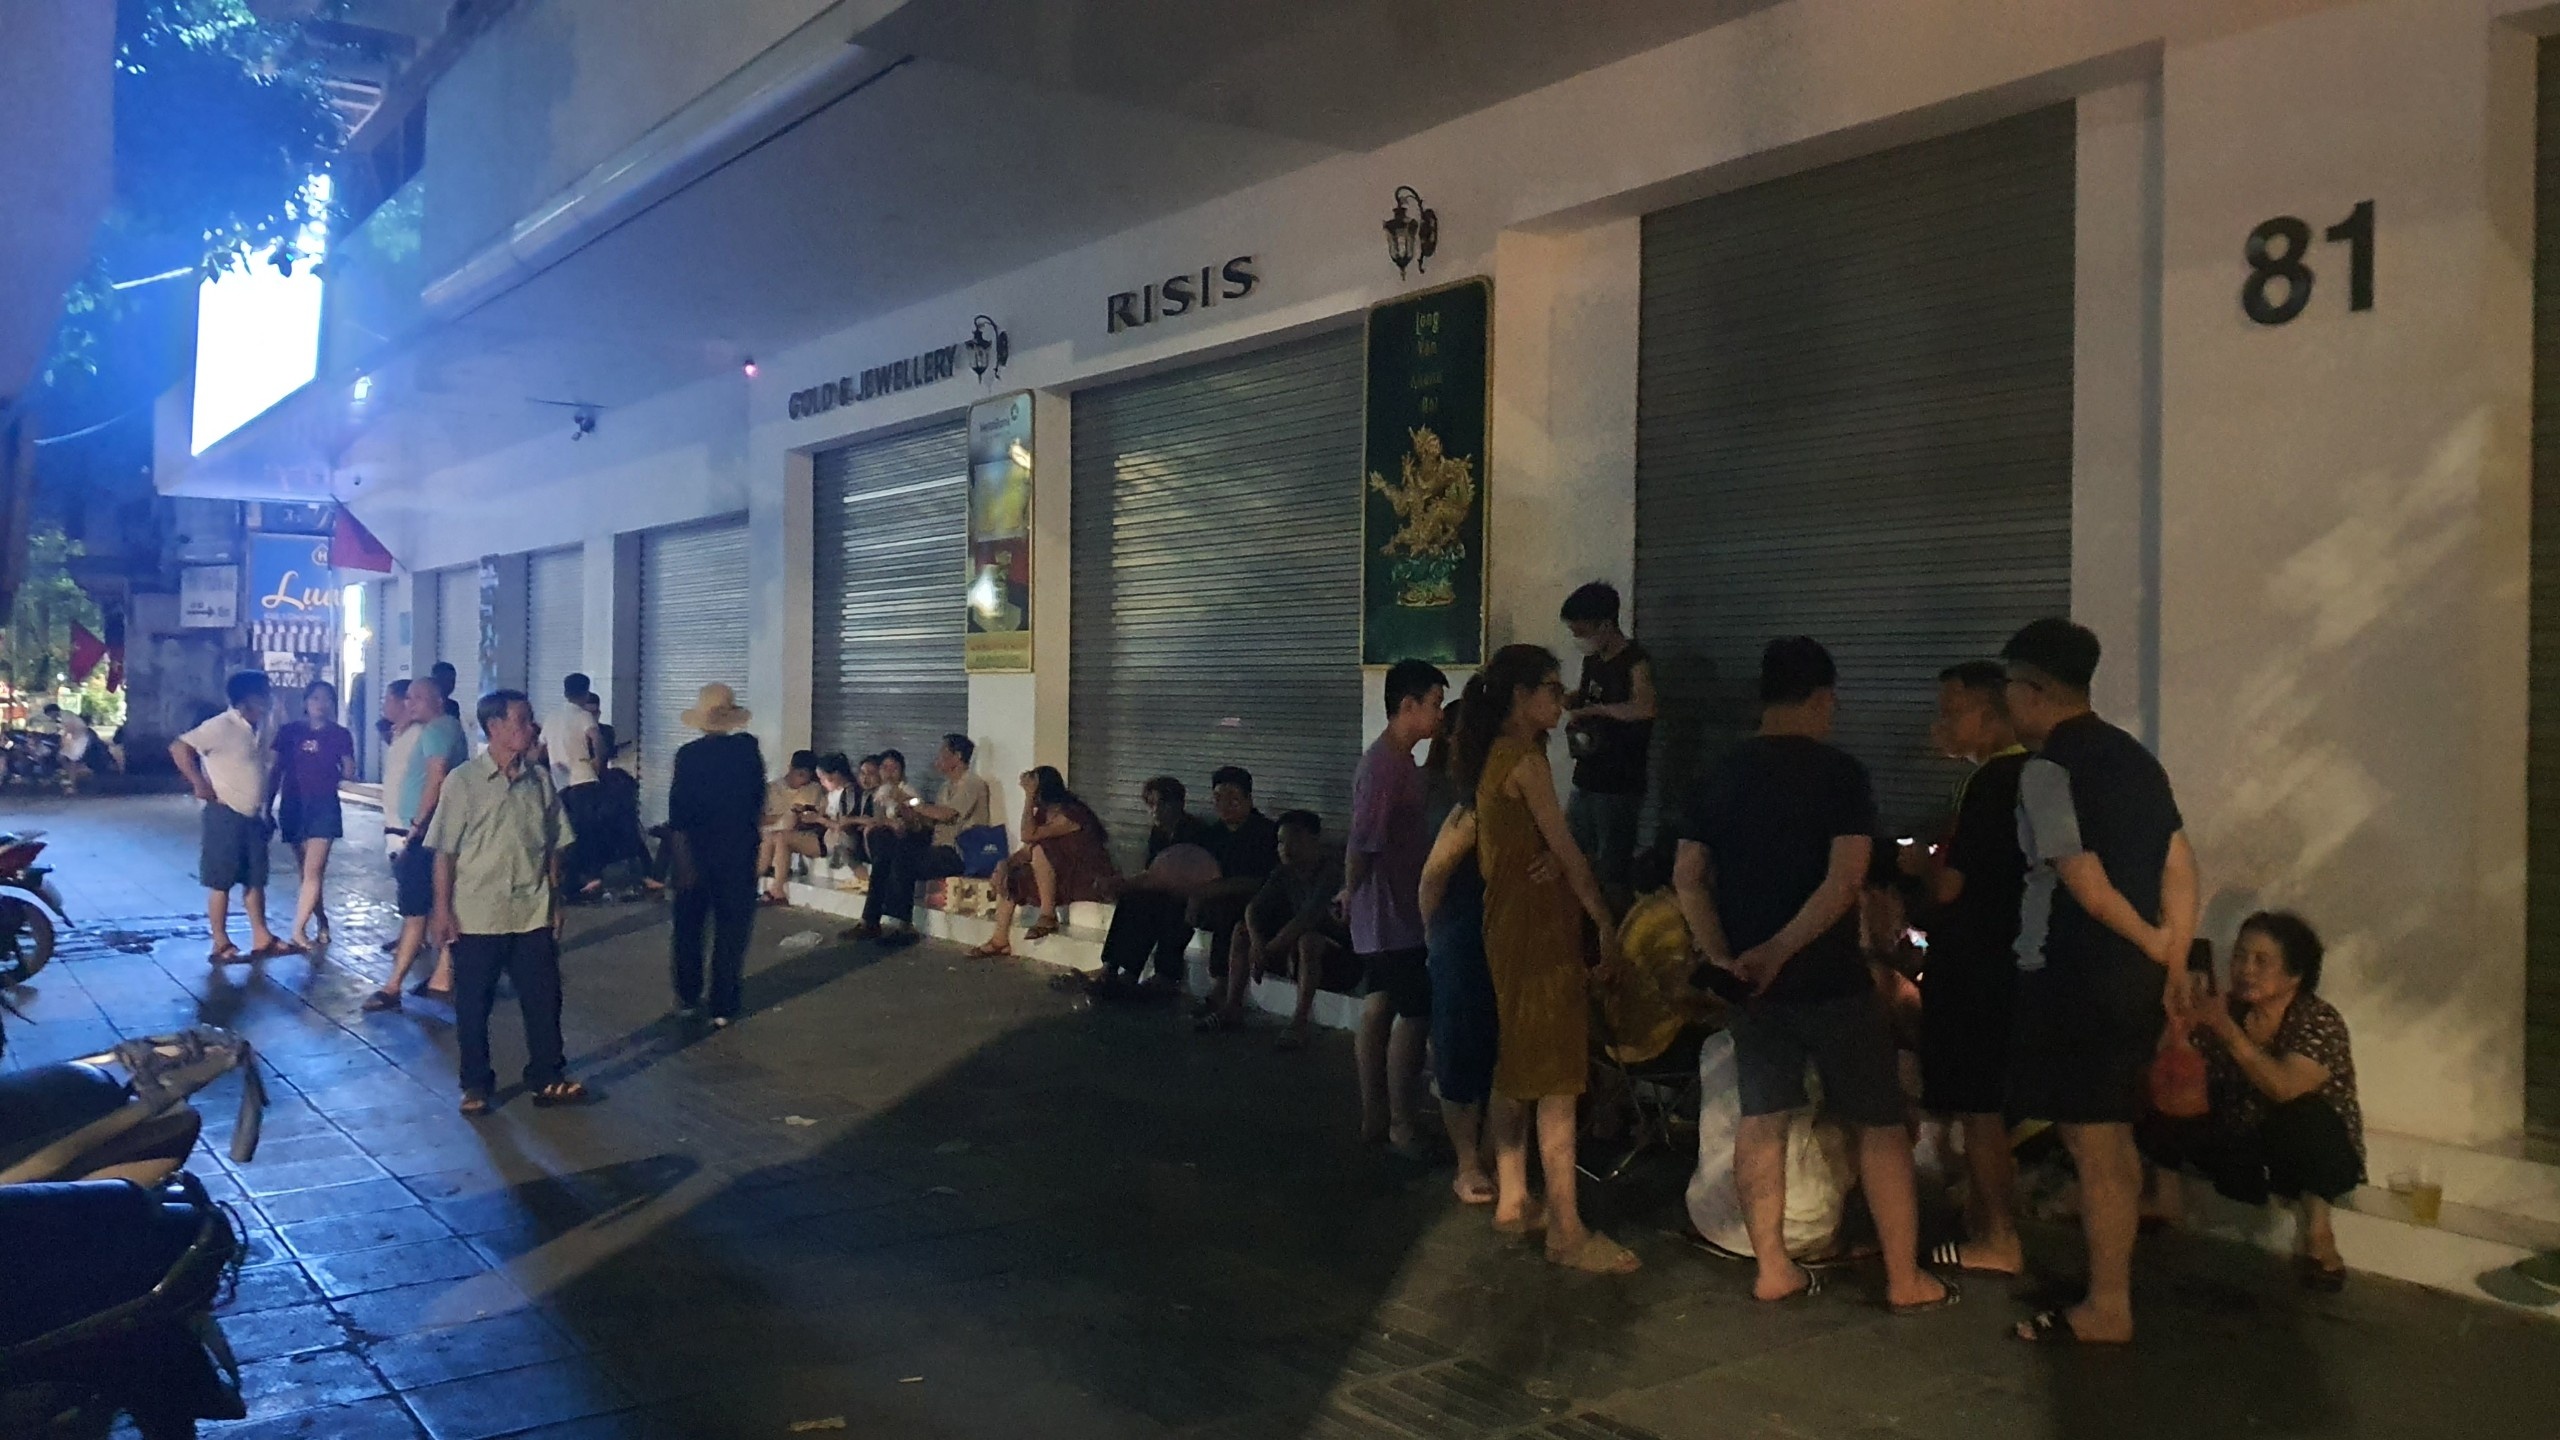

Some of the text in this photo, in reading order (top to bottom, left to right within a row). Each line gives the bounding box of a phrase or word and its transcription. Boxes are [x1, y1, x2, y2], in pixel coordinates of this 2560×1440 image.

[1107, 256, 1257, 333] RISIS
[2243, 199, 2374, 324] 81
[788, 382, 836, 420] GOLD
[857, 344, 957, 401] JEWELLERY
